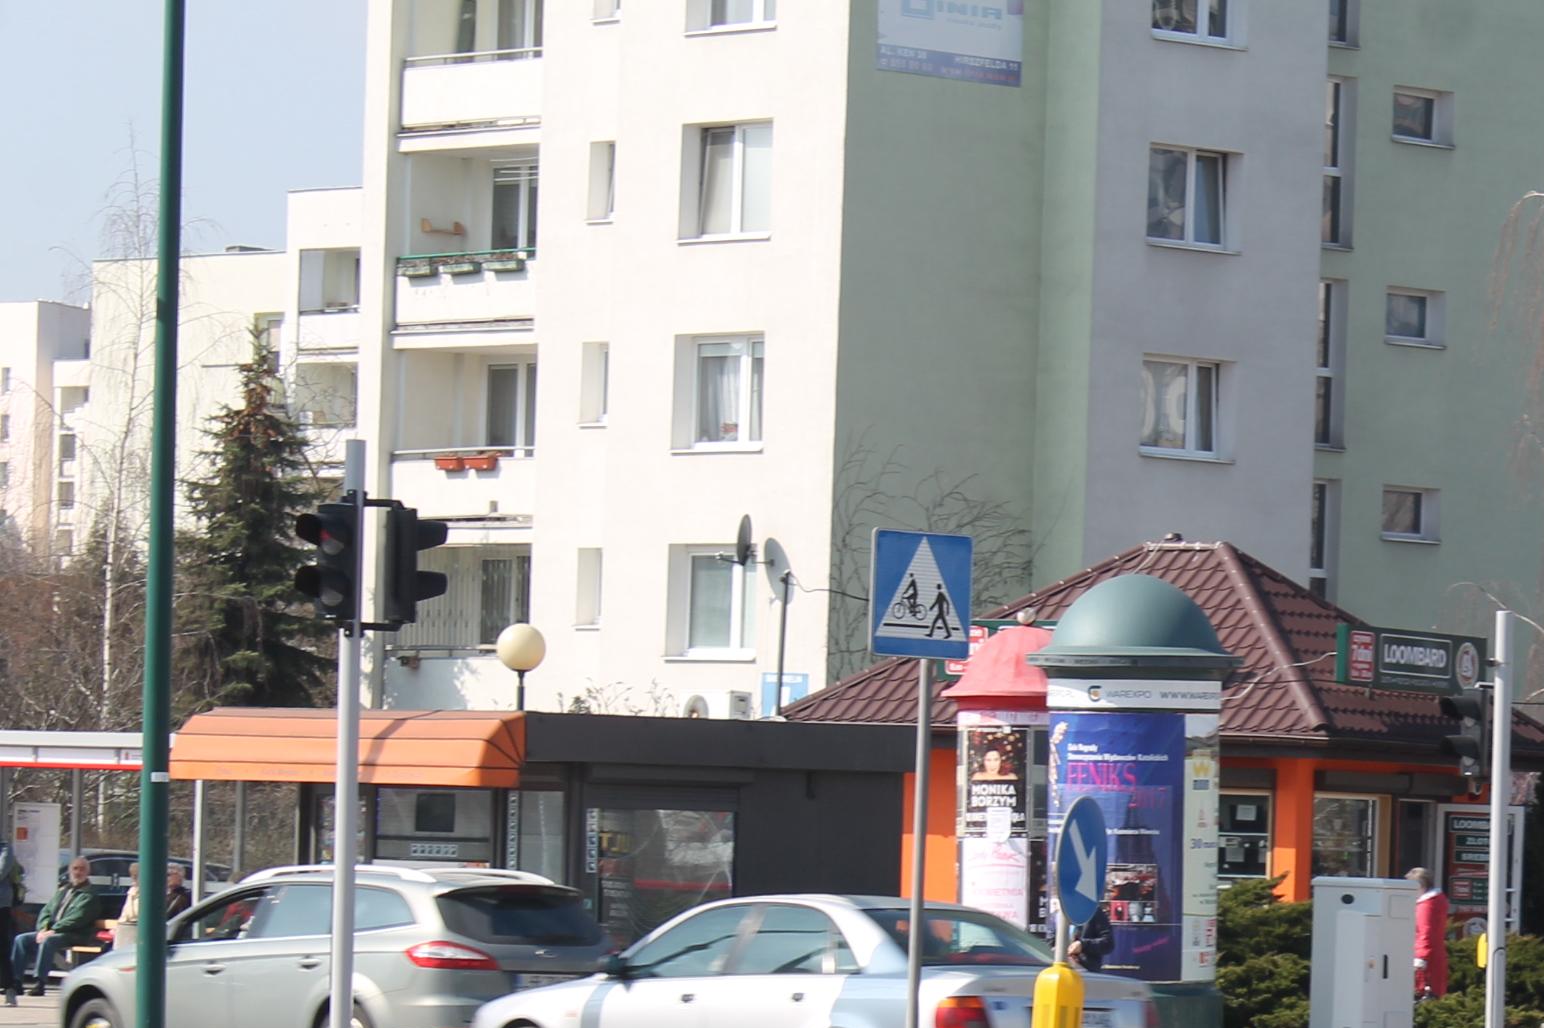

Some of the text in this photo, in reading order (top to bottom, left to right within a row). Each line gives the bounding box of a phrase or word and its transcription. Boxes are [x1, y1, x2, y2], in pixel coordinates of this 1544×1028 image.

[1384, 643, 1447, 668] LOOMBARD
[1067, 762, 1136, 791] FENIKS
[972, 784, 1016, 796] MONIKA
[971, 796, 1017, 808] BORZYM
